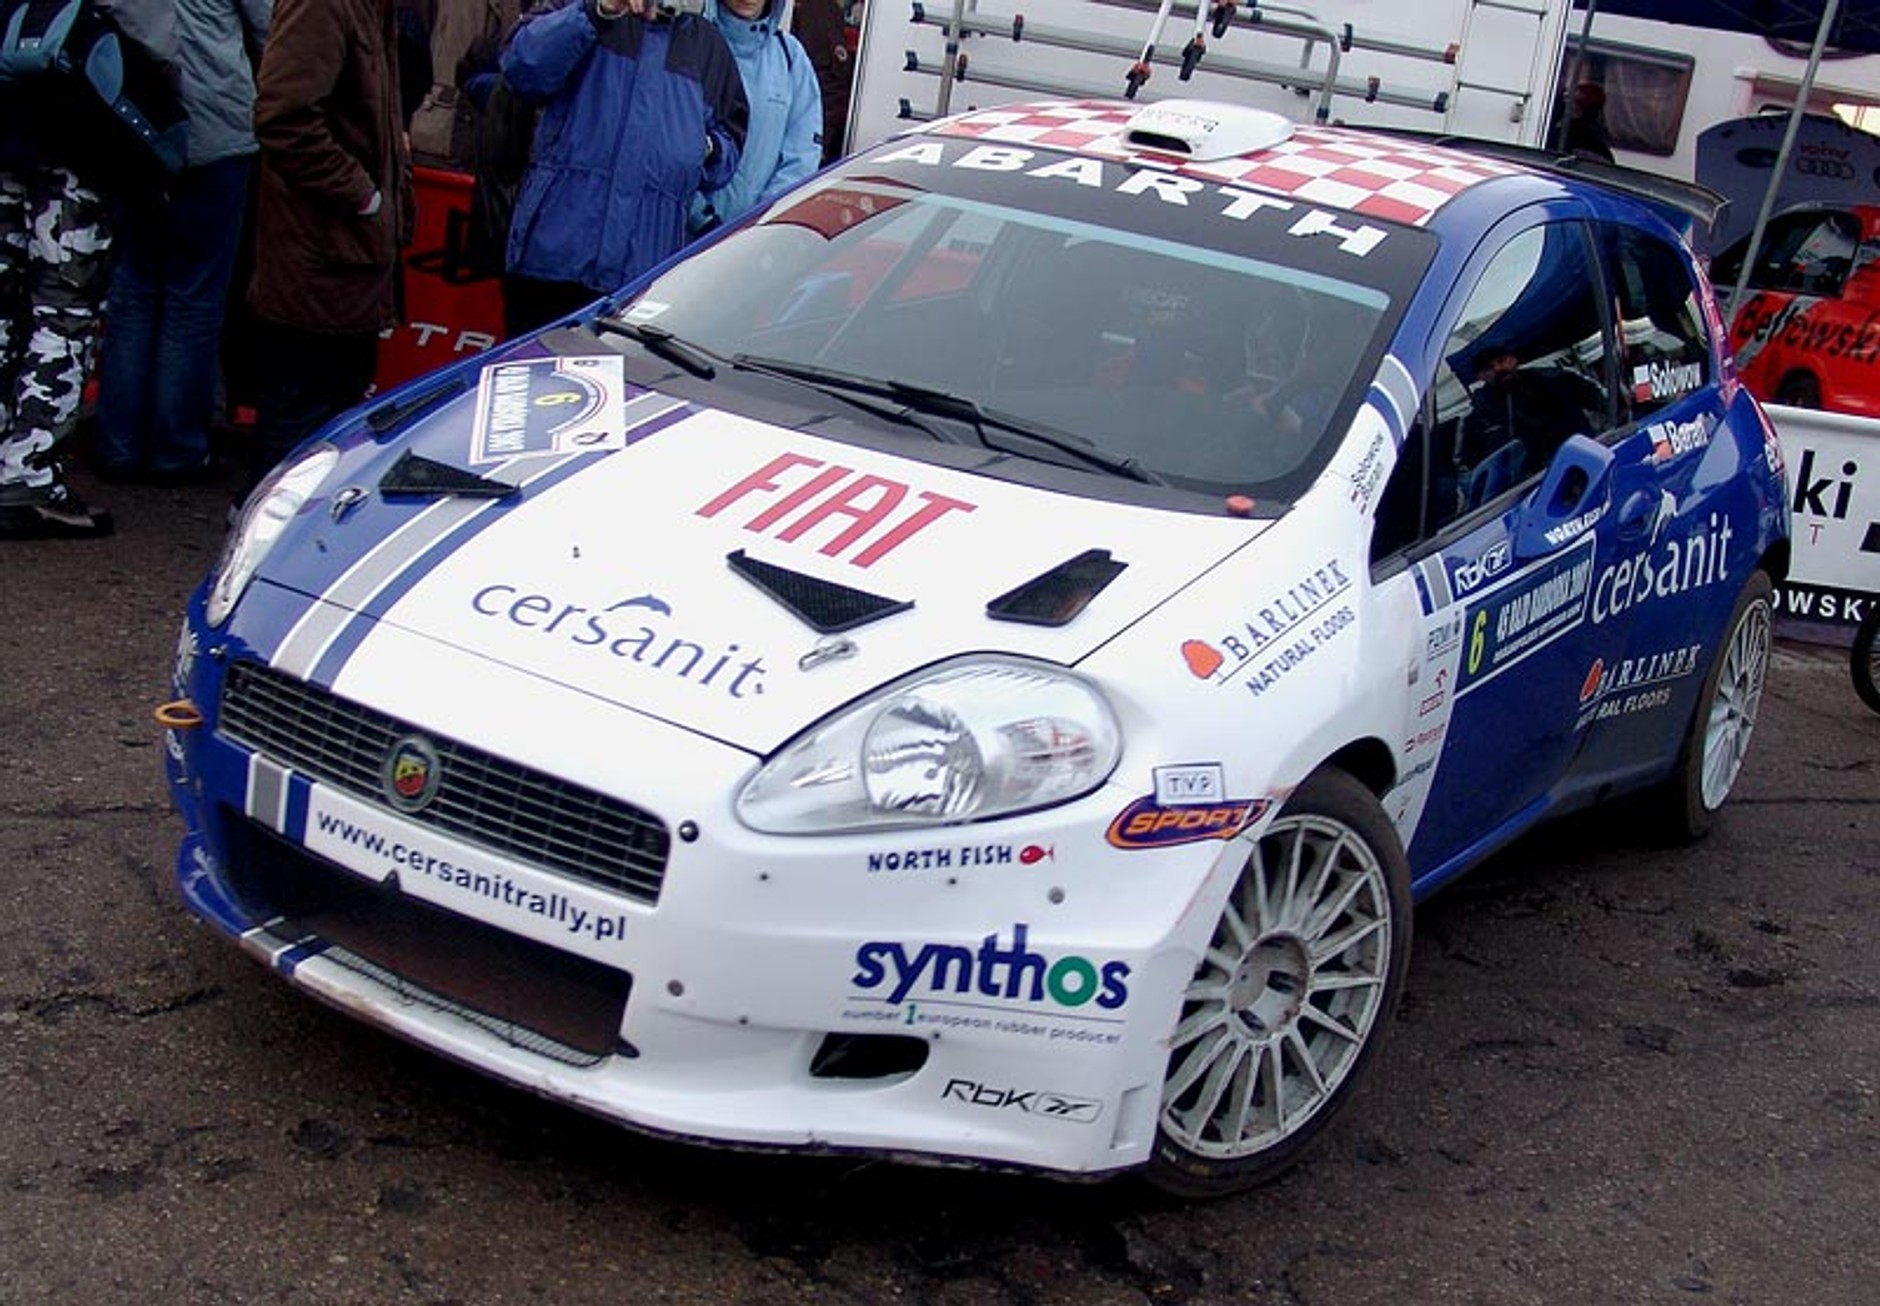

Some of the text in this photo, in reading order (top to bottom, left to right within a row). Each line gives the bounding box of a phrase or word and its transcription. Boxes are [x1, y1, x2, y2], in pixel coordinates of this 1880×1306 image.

[869, 142, 1390, 258] ABARTH
[534, 391, 582, 406] 6
[694, 451, 980, 569] FIAT
[1221, 559, 1350, 662] BARLINEK
[1591, 512, 1733, 625] cersanit
[1772, 588, 1877, 622] WSK
[471, 584, 767, 699] cersanit
[1245, 605, 1356, 697] NATURAL FLOORS
[1468, 609, 1488, 676] 6
[1124, 805, 1249, 836] SPORT
[1168, 775, 1213, 797] TVP
[316, 810, 627, 942] www.cersanitrally.pl
[867, 845, 1013, 873] NORTH FISH
[851, 923, 1132, 1010] synthos
[842, 1003, 1123, 1045] number 1 european rubber producer
